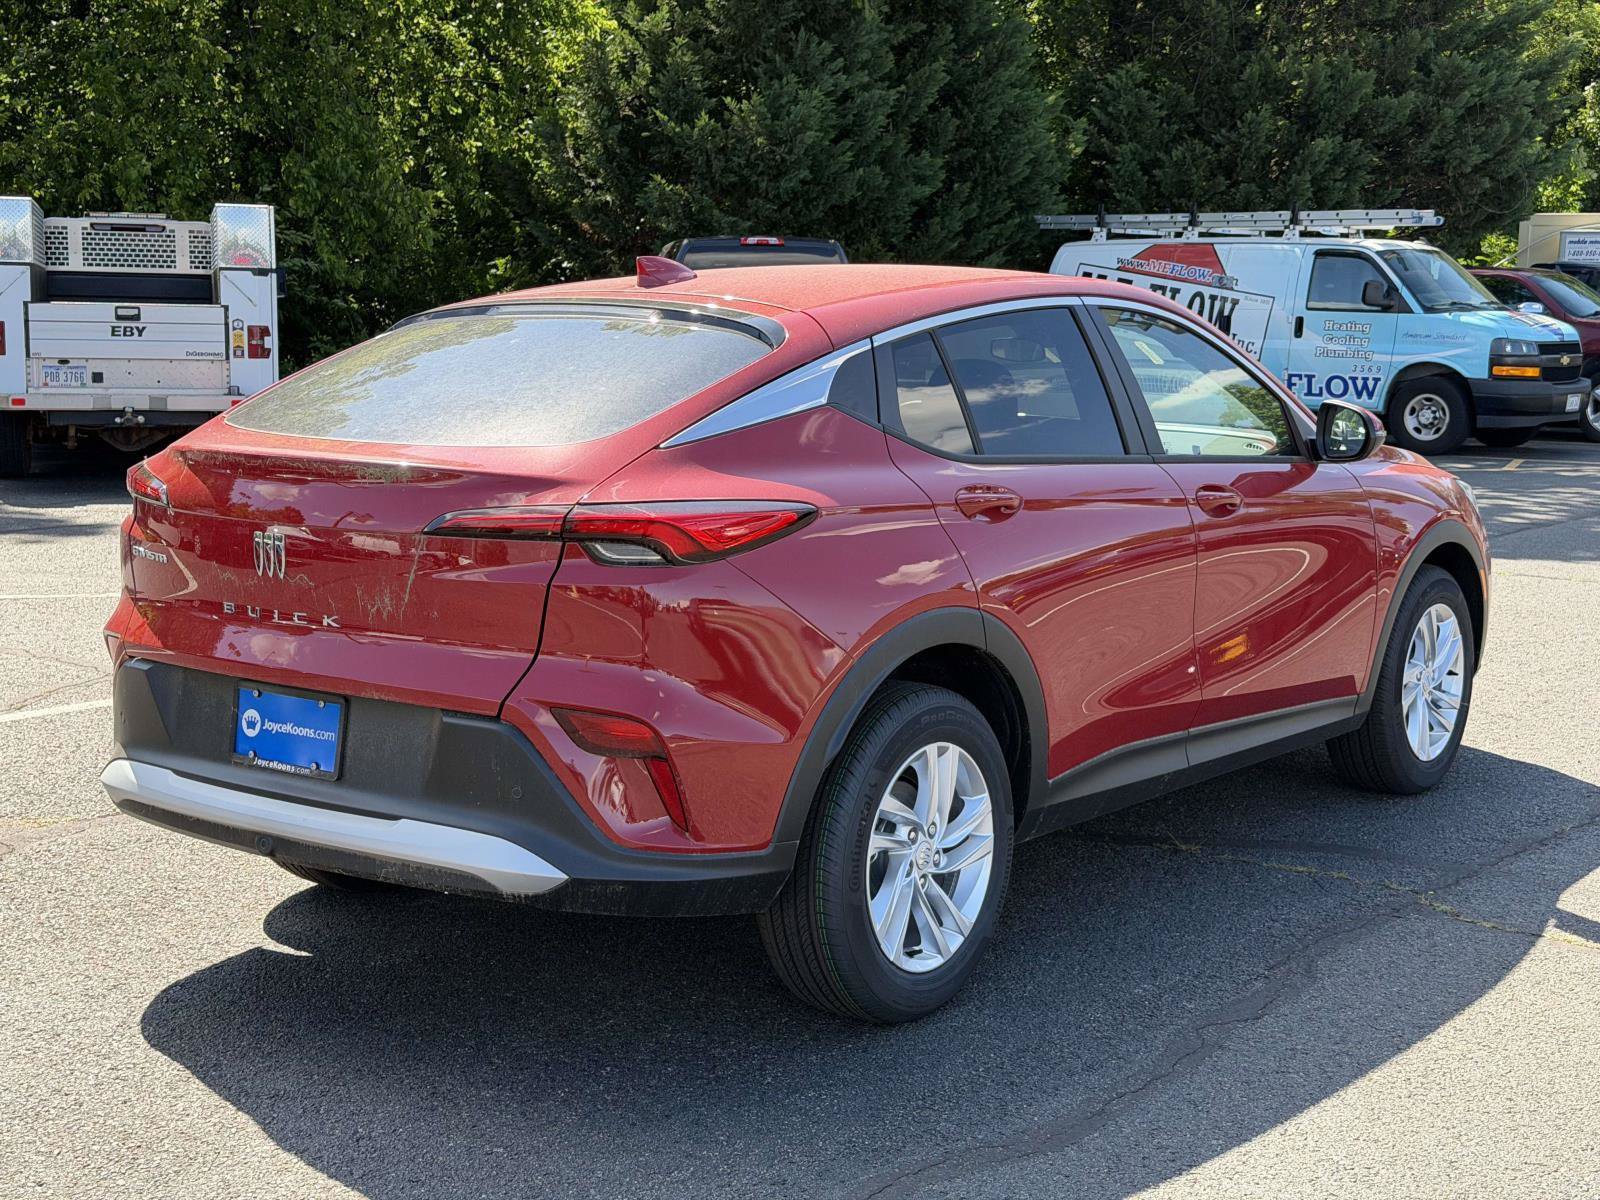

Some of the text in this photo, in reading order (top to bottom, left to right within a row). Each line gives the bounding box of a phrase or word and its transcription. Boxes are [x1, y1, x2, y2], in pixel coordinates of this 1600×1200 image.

[110, 325, 147, 337] EBY
[1323, 319, 1371, 333] Heating
[1322, 334, 1370, 347] Cooling
[1315, 347, 1374, 361] Plumbing
[1352, 364, 1382, 374] 3569
[1287, 373, 1382, 400] FLOW
[223, 601, 341, 628] BUICK
[262, 718, 336, 741] JoyceKoons.com
[253, 757, 311, 775] JoyceKoons.com
